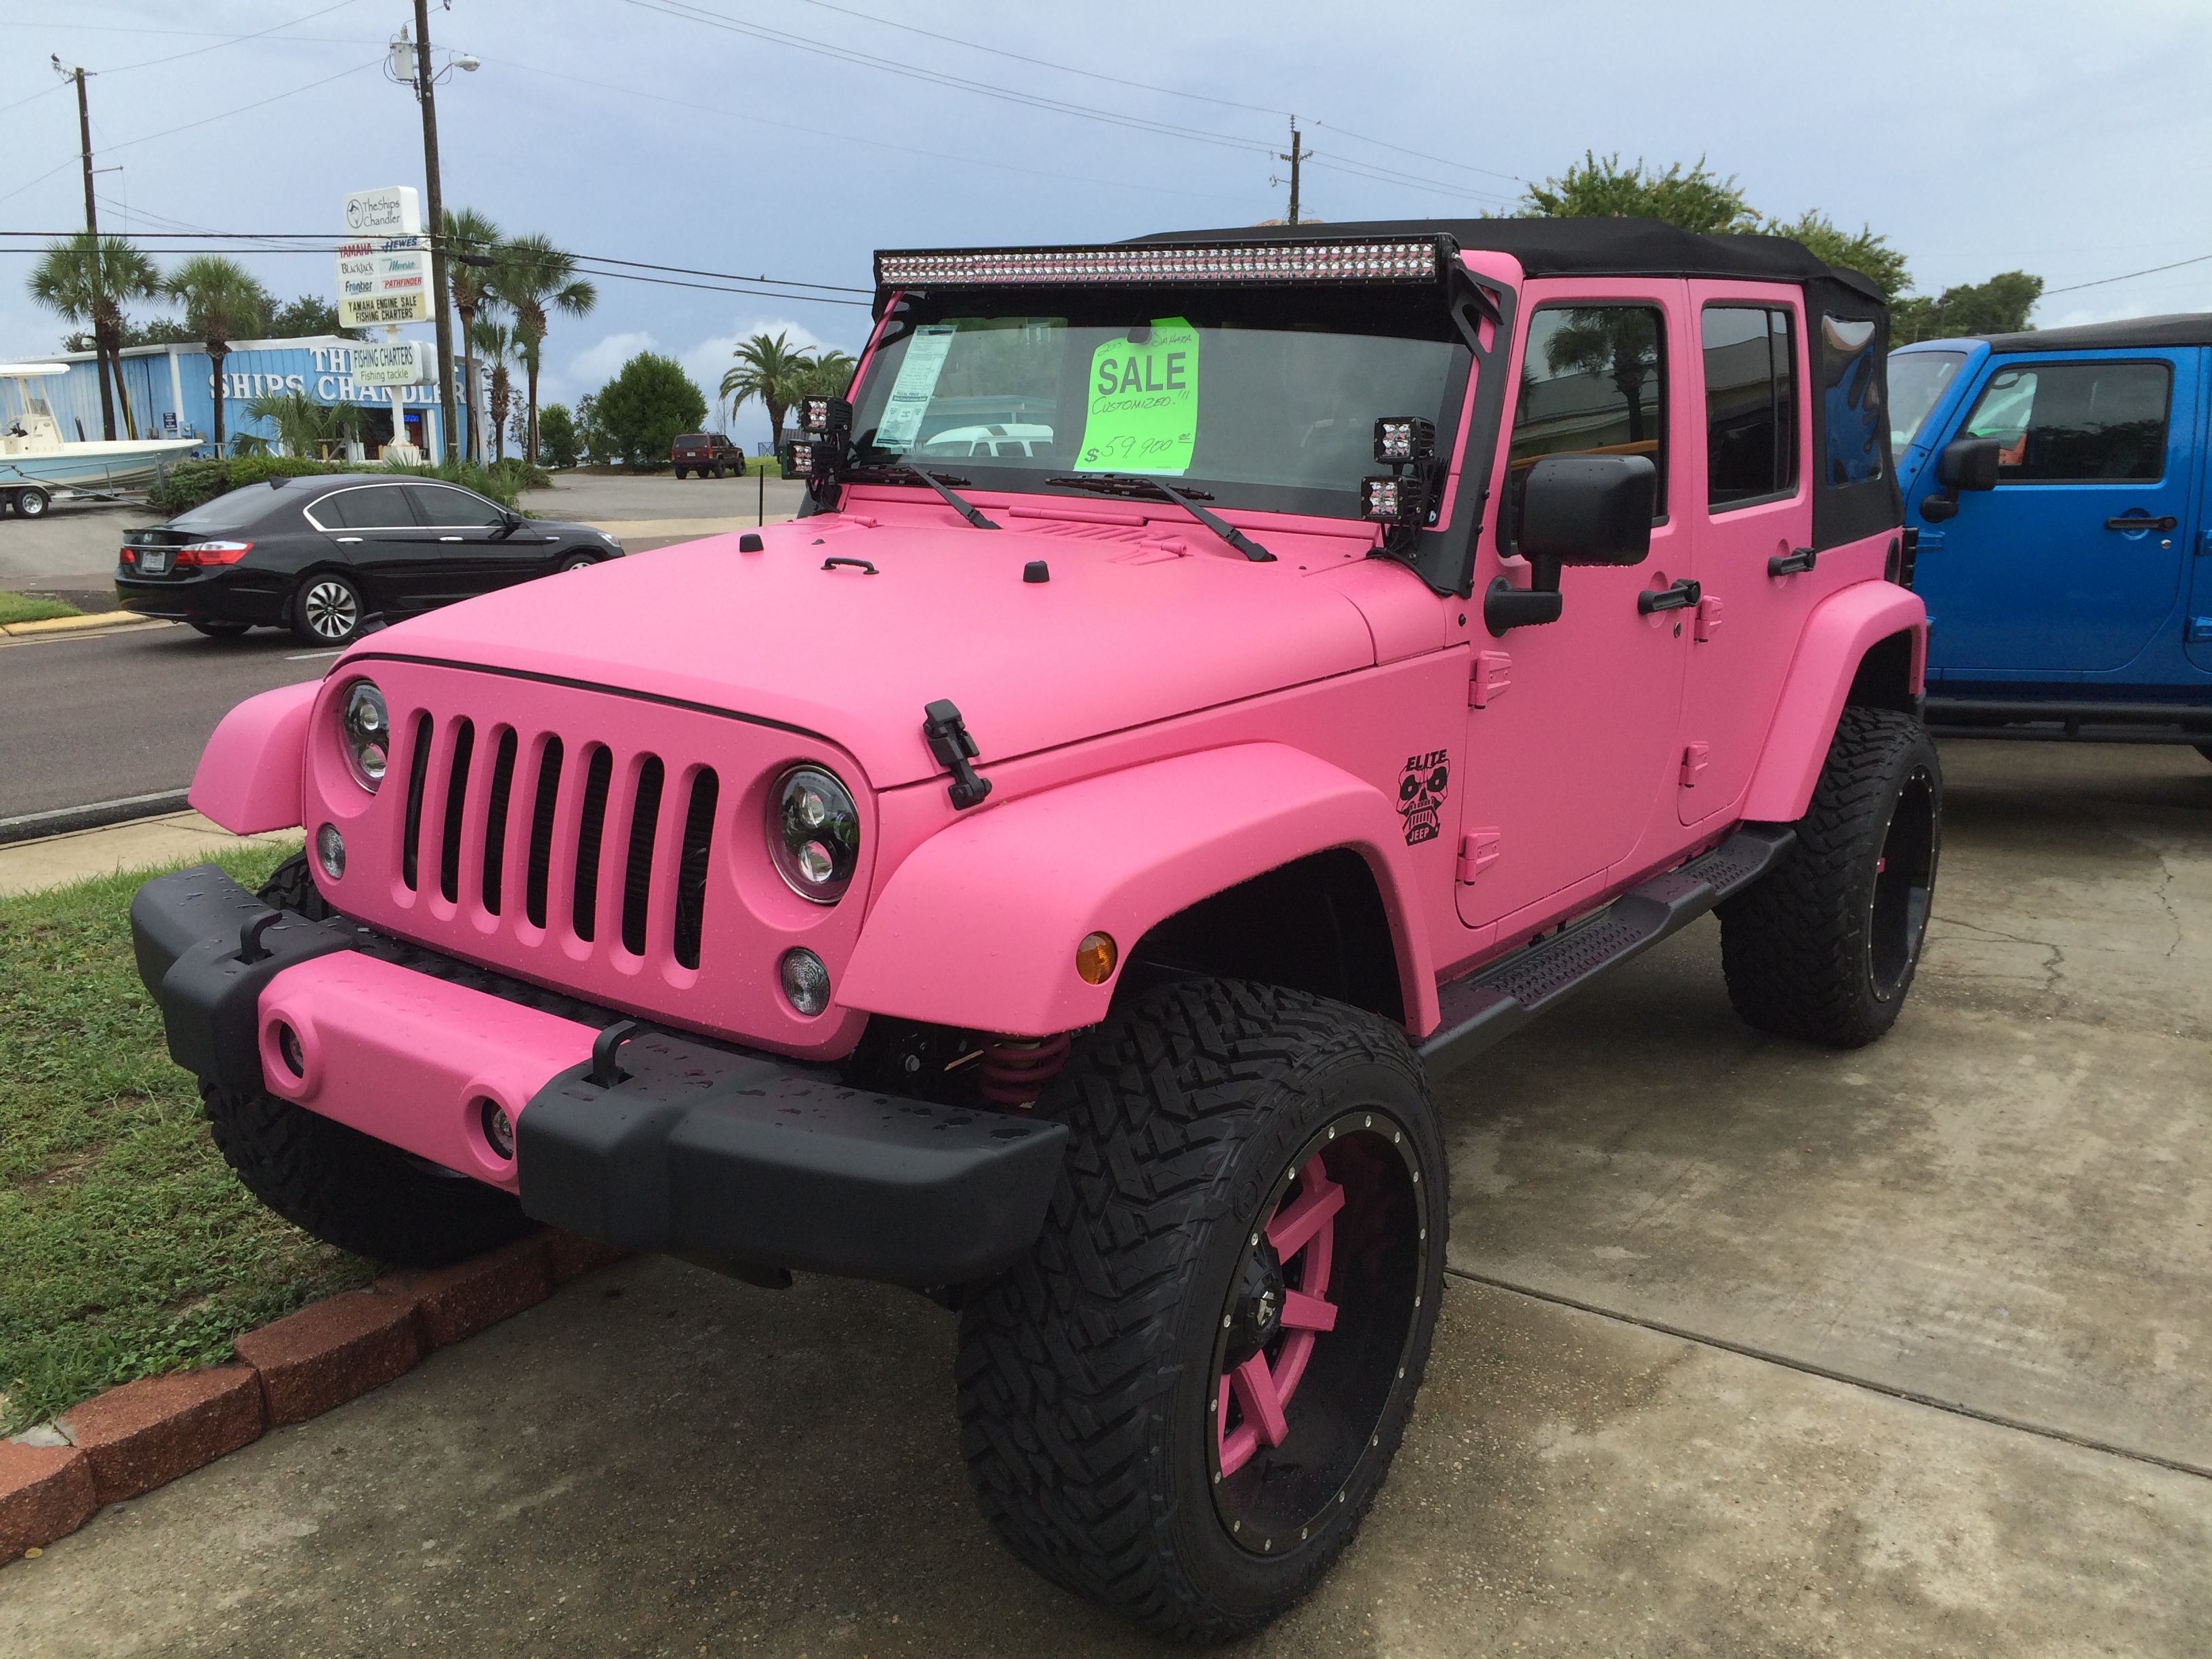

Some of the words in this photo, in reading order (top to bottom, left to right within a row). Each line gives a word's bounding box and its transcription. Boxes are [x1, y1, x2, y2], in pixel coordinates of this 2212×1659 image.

[364, 211, 401, 226] Chandler
[339, 243, 373, 258] YAMAHA
[380, 237, 417, 252] HEWES
[383, 276, 422, 289] PATHFINDER
[348, 300, 375, 312] YAMAHA
[376, 298, 398, 310] ENGINE
[401, 295, 417, 307] SALE
[356, 310, 379, 322] FISHING
[382, 308, 413, 320] CHARTERS
[310, 347, 353, 373] TH
[354, 348, 379, 368] FISHING
[380, 346, 413, 367] CHARTERS
[361, 370, 385, 382] Fishing
[387, 368, 408, 380] tackle
[1098, 352, 1186, 395] SALE
[209, 373, 305, 399] SHIPS
[1406, 749, 1448, 772] ELITE
[1409, 827, 1430, 842] JEEP
